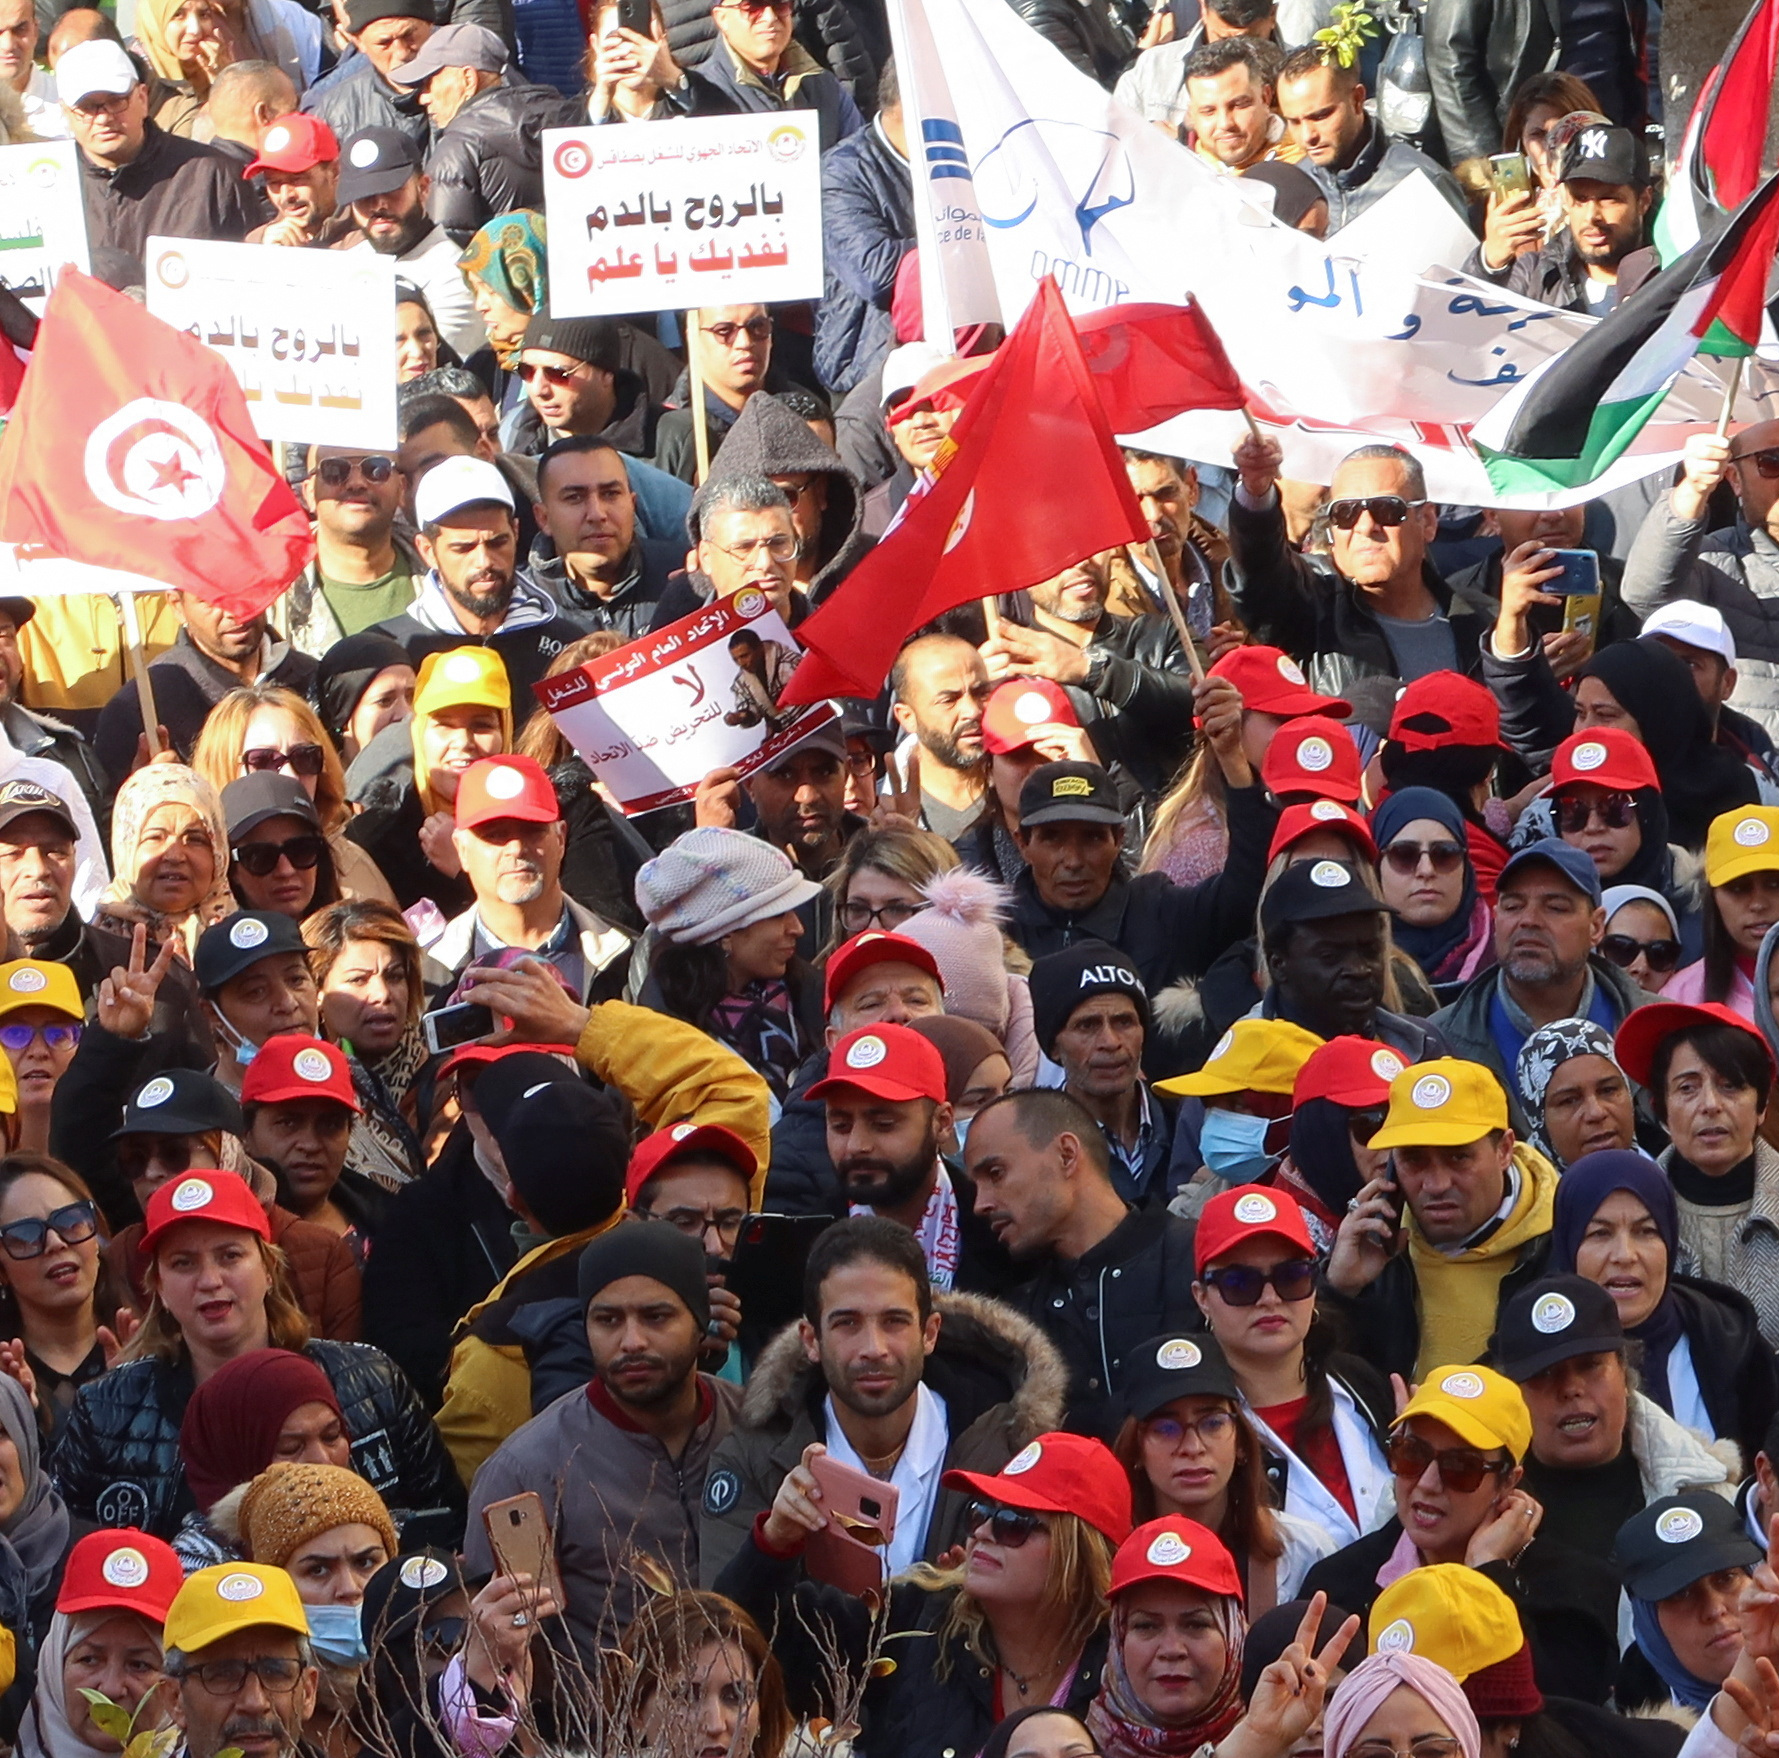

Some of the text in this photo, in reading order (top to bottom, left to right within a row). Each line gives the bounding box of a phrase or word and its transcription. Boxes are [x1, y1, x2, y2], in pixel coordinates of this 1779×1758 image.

[1579, 129, 1608, 159] NY
[586, 182, 784, 242] بالروح بالدم
[587, 231, 789, 294] نفديك يا علم
[271, 322, 360, 366] بالروح
[547, 675, 588, 709] للشغل
[671, 662, 706, 708] لا
